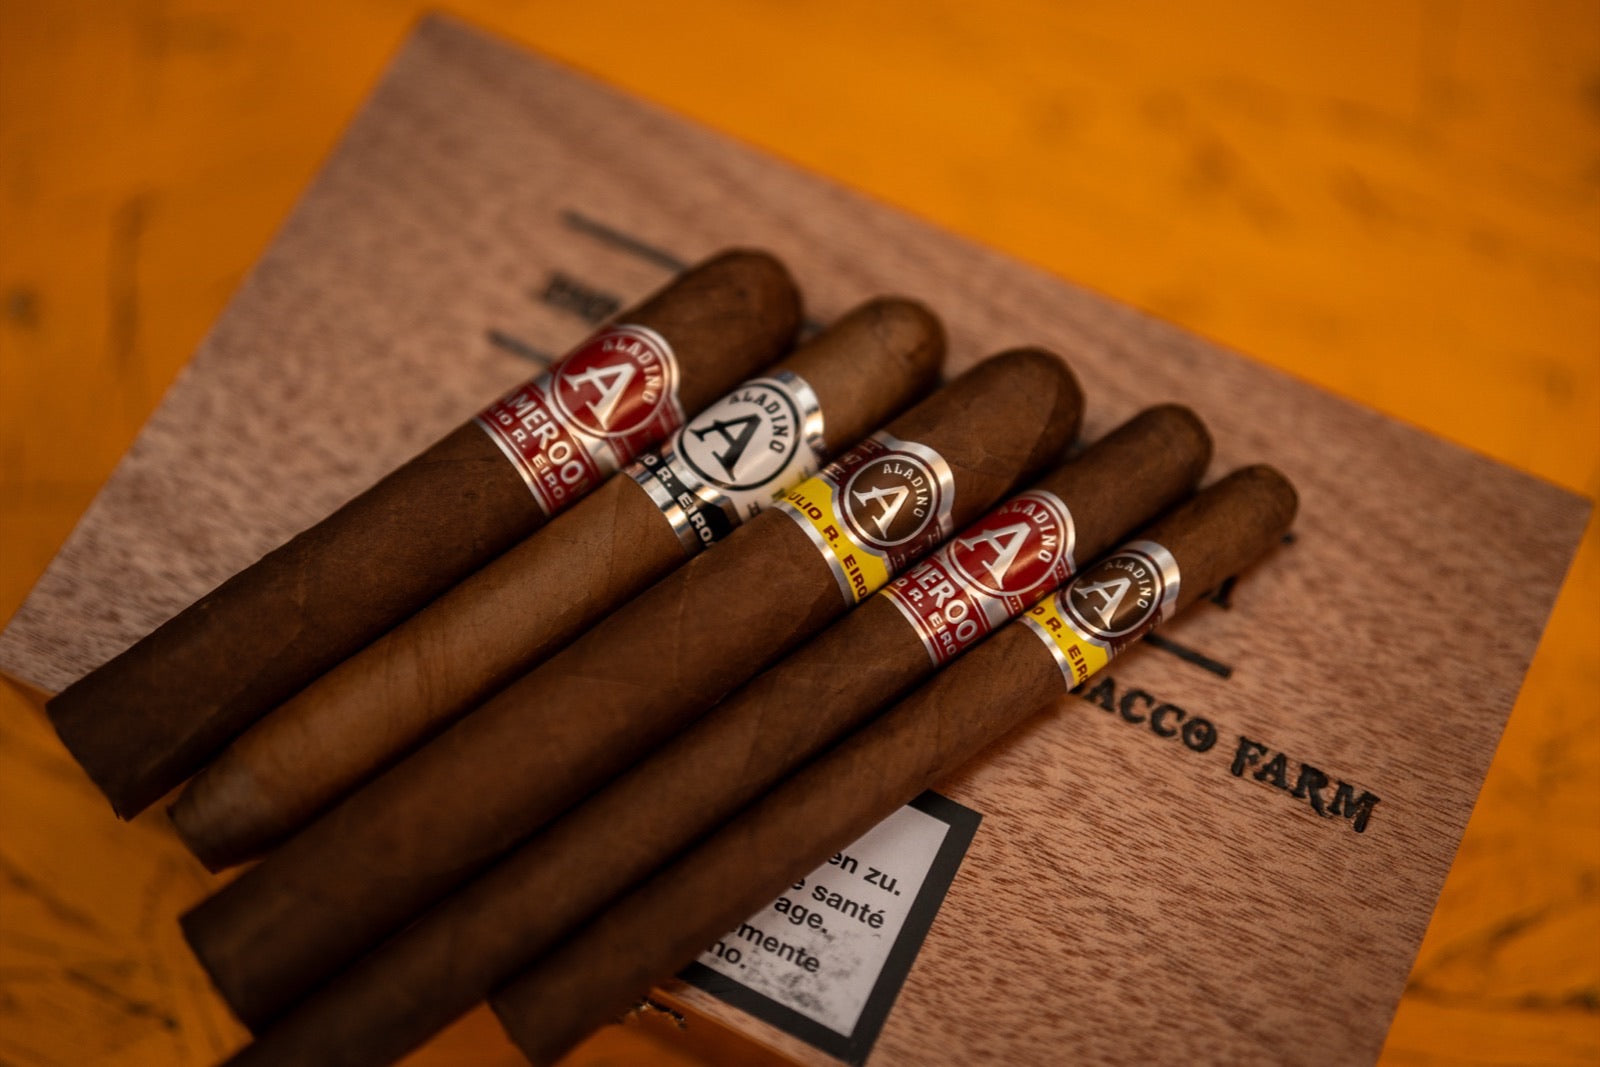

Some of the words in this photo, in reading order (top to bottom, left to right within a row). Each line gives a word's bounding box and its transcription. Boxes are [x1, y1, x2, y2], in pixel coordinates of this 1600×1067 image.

[562, 362, 637, 431] A
[602, 337, 662, 405] ALADINO
[688, 413, 762, 482] A
[729, 390, 788, 455] ALADINO
[656, 470, 672, 488] R.
[677, 492, 714, 545] EIRO
[852, 485, 910, 540] A
[882, 463, 930, 518] ALADINO
[788, 492, 824, 521] ULIO
[823, 525, 840, 548] R.
[998, 501, 1057, 564] ALADINO
[958, 521, 1032, 590] A
[907, 590, 924, 608] R.
[1074, 576, 1131, 630] A
[1104, 559, 1152, 609] ALADINO
[1045, 616, 1062, 639] R.
[1076, 676, 1218, 753] ACCO
[1231, 735, 1380, 833] FARM
[812, 881, 886, 930] santé
[864, 866, 902, 896] zu.
[774, 896, 828, 934] age.
[732, 923, 821, 973] mente
